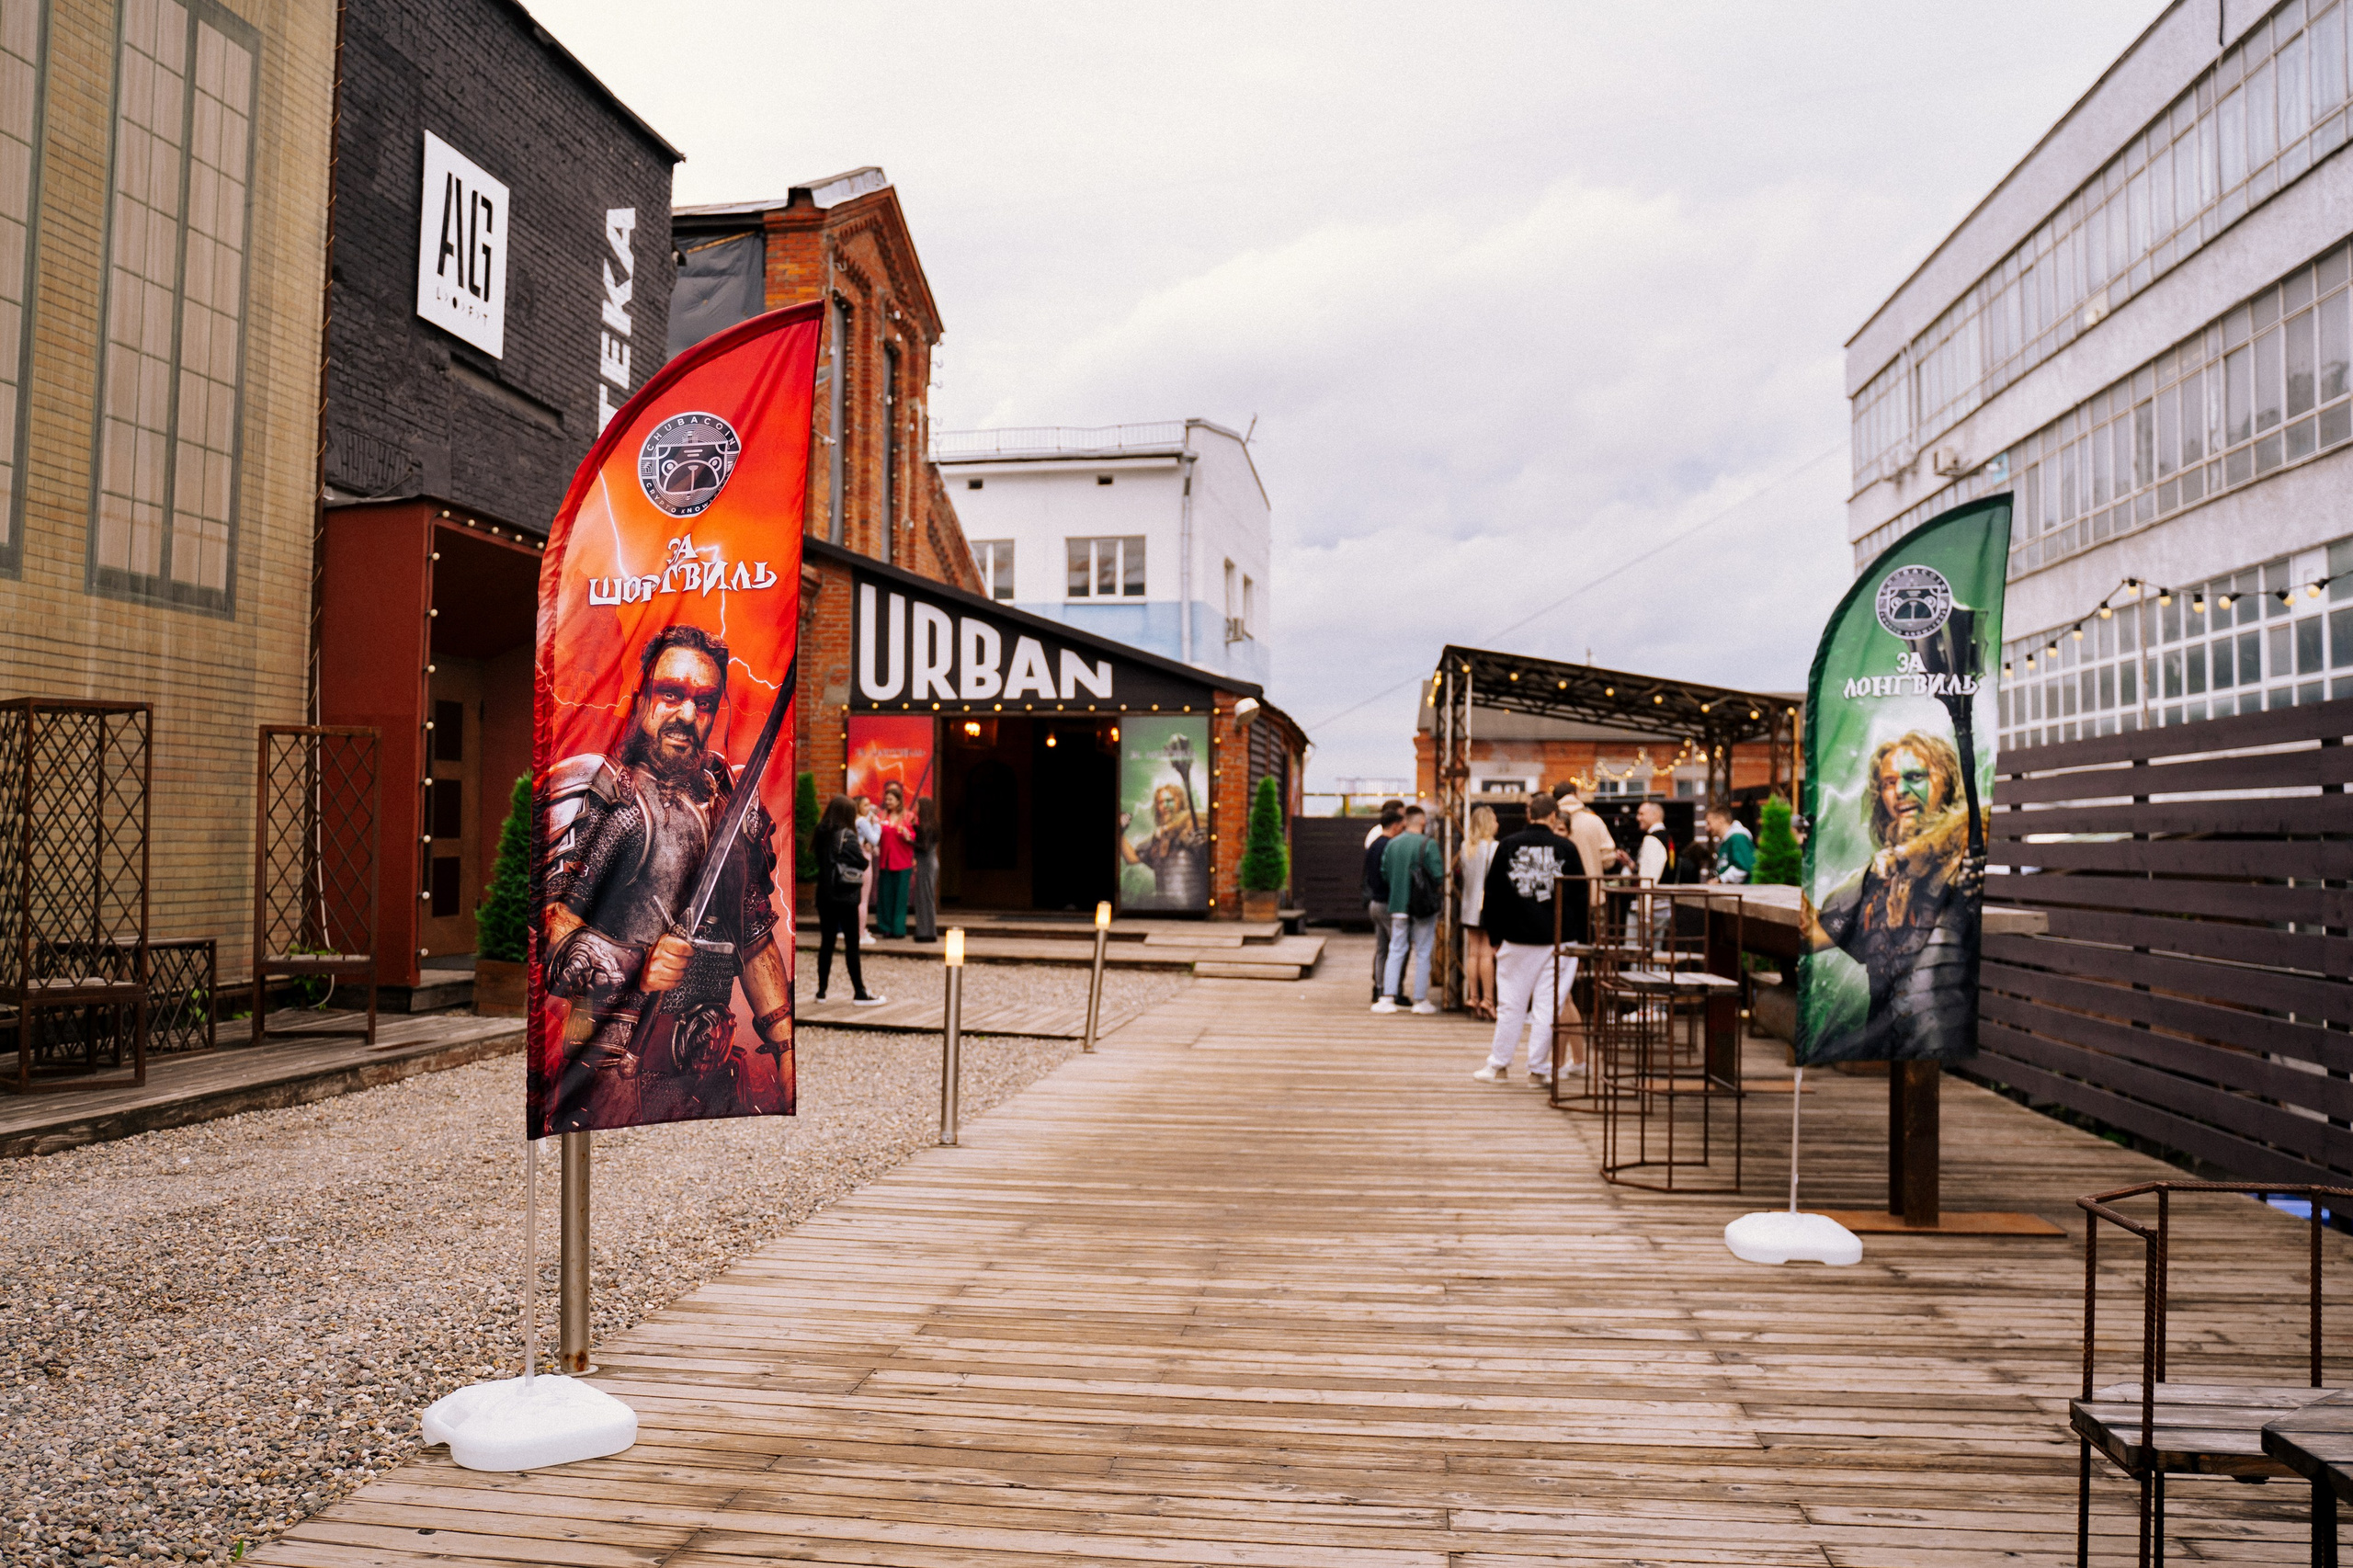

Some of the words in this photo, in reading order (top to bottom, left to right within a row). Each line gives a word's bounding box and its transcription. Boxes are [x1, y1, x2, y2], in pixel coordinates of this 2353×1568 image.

[438, 171, 493, 303] AG
[646, 416, 736, 451] CHUBACOIN
[666, 533, 699, 565] ЗА
[589, 561, 779, 606] ШОРГВИЛЬ
[859, 582, 1113, 701] URBAN
[1895, 652, 1928, 674] ЗА
[1843, 672, 1980, 699] ЛОНГВИЛЬ
